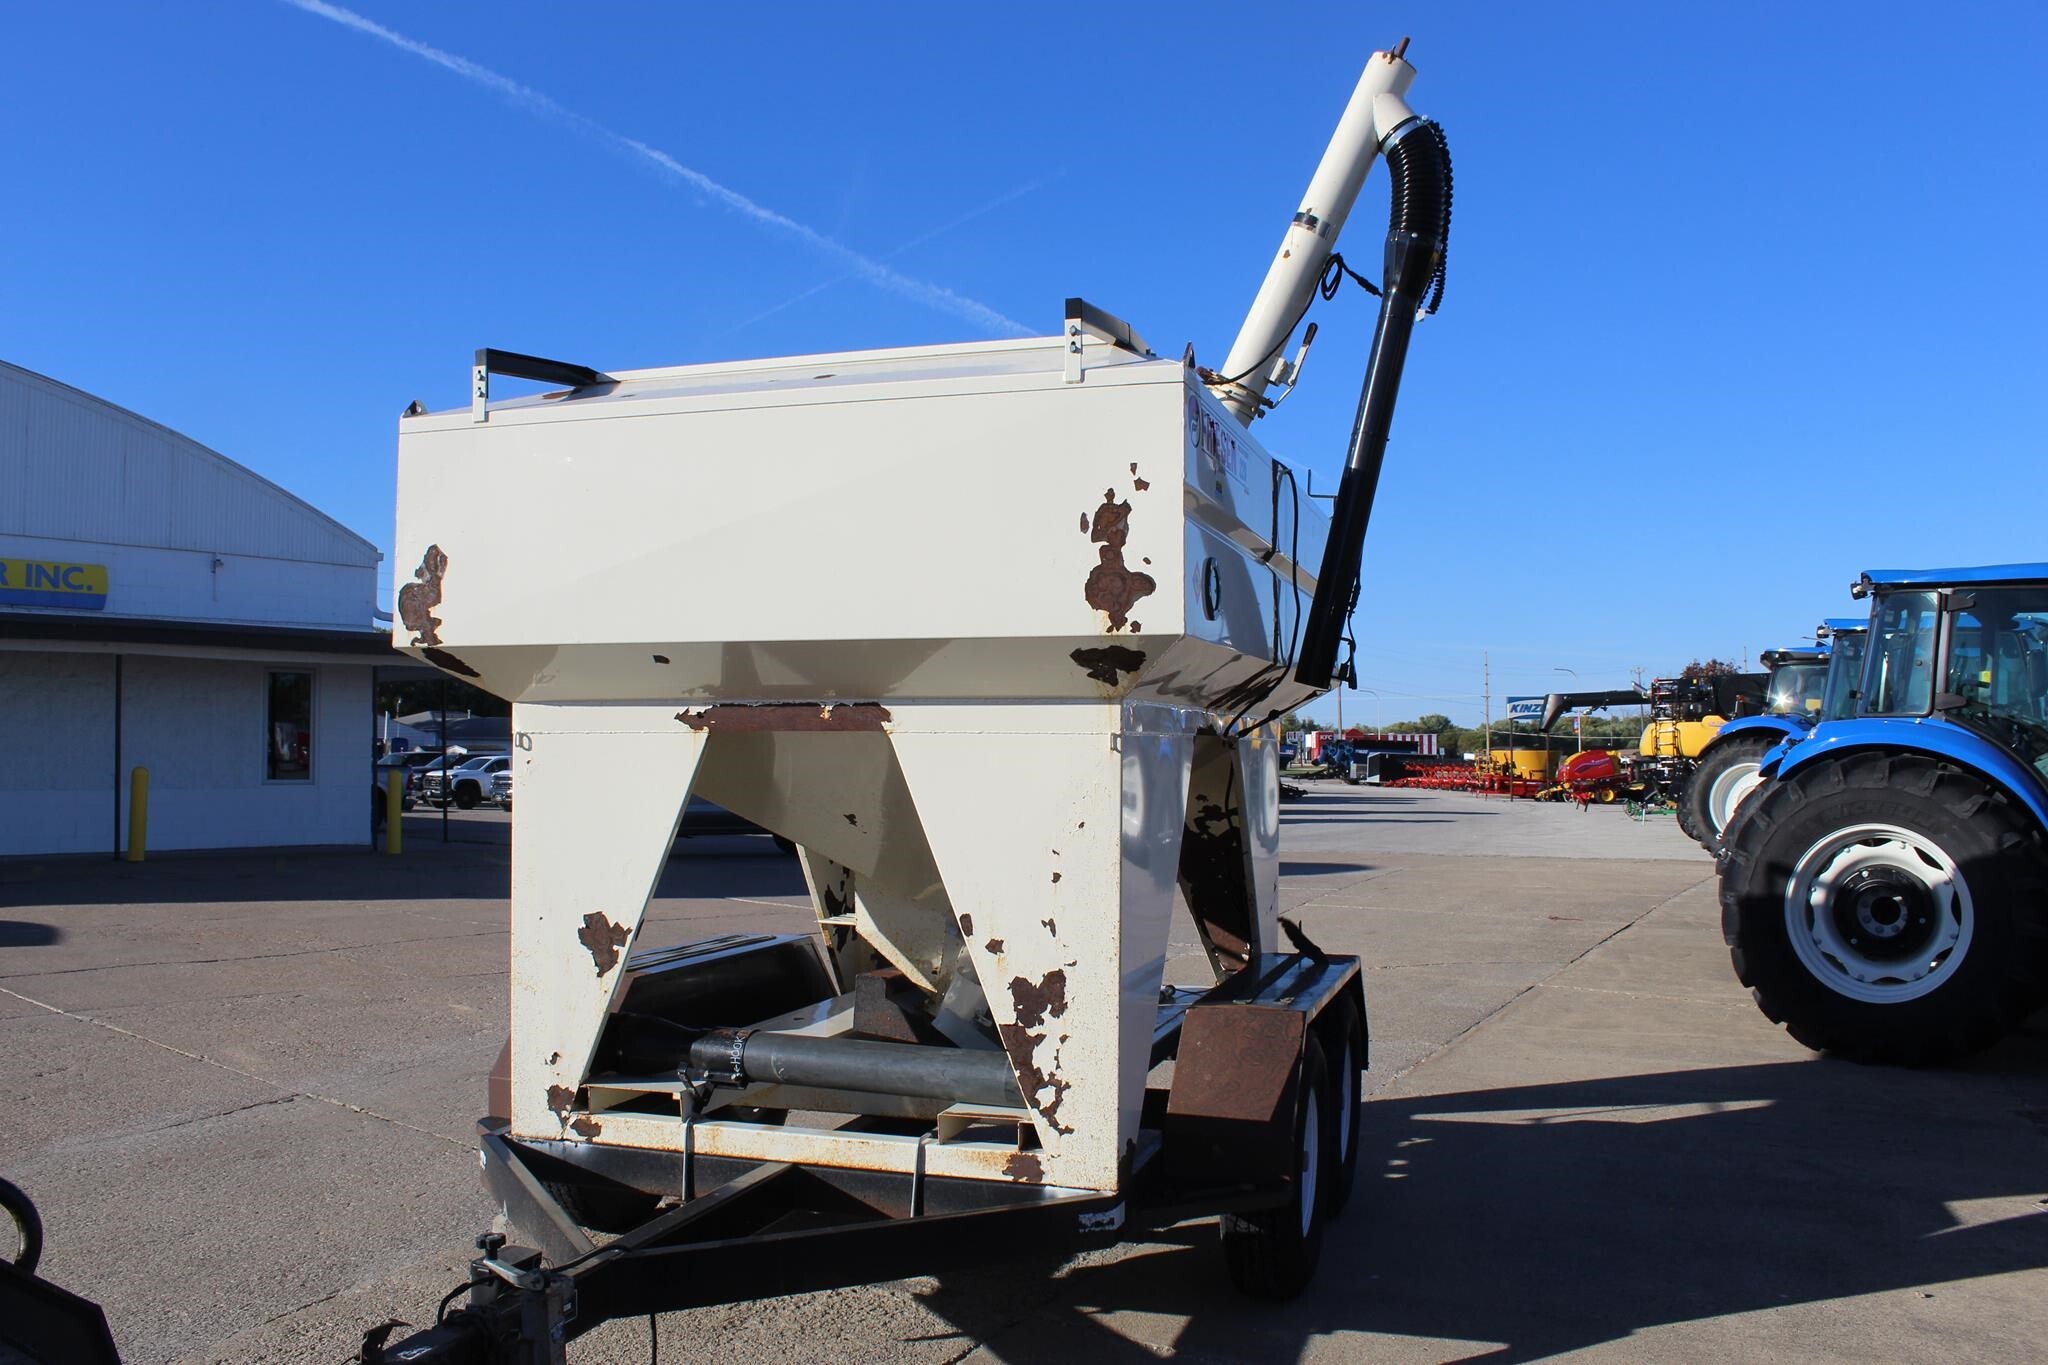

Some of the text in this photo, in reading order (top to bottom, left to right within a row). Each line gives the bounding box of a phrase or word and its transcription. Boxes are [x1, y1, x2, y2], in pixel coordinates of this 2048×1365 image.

[25, 562, 93, 591] INC.
[1510, 703, 1543, 713] KINZ
[730, 1036, 746, 1064] HOOK
